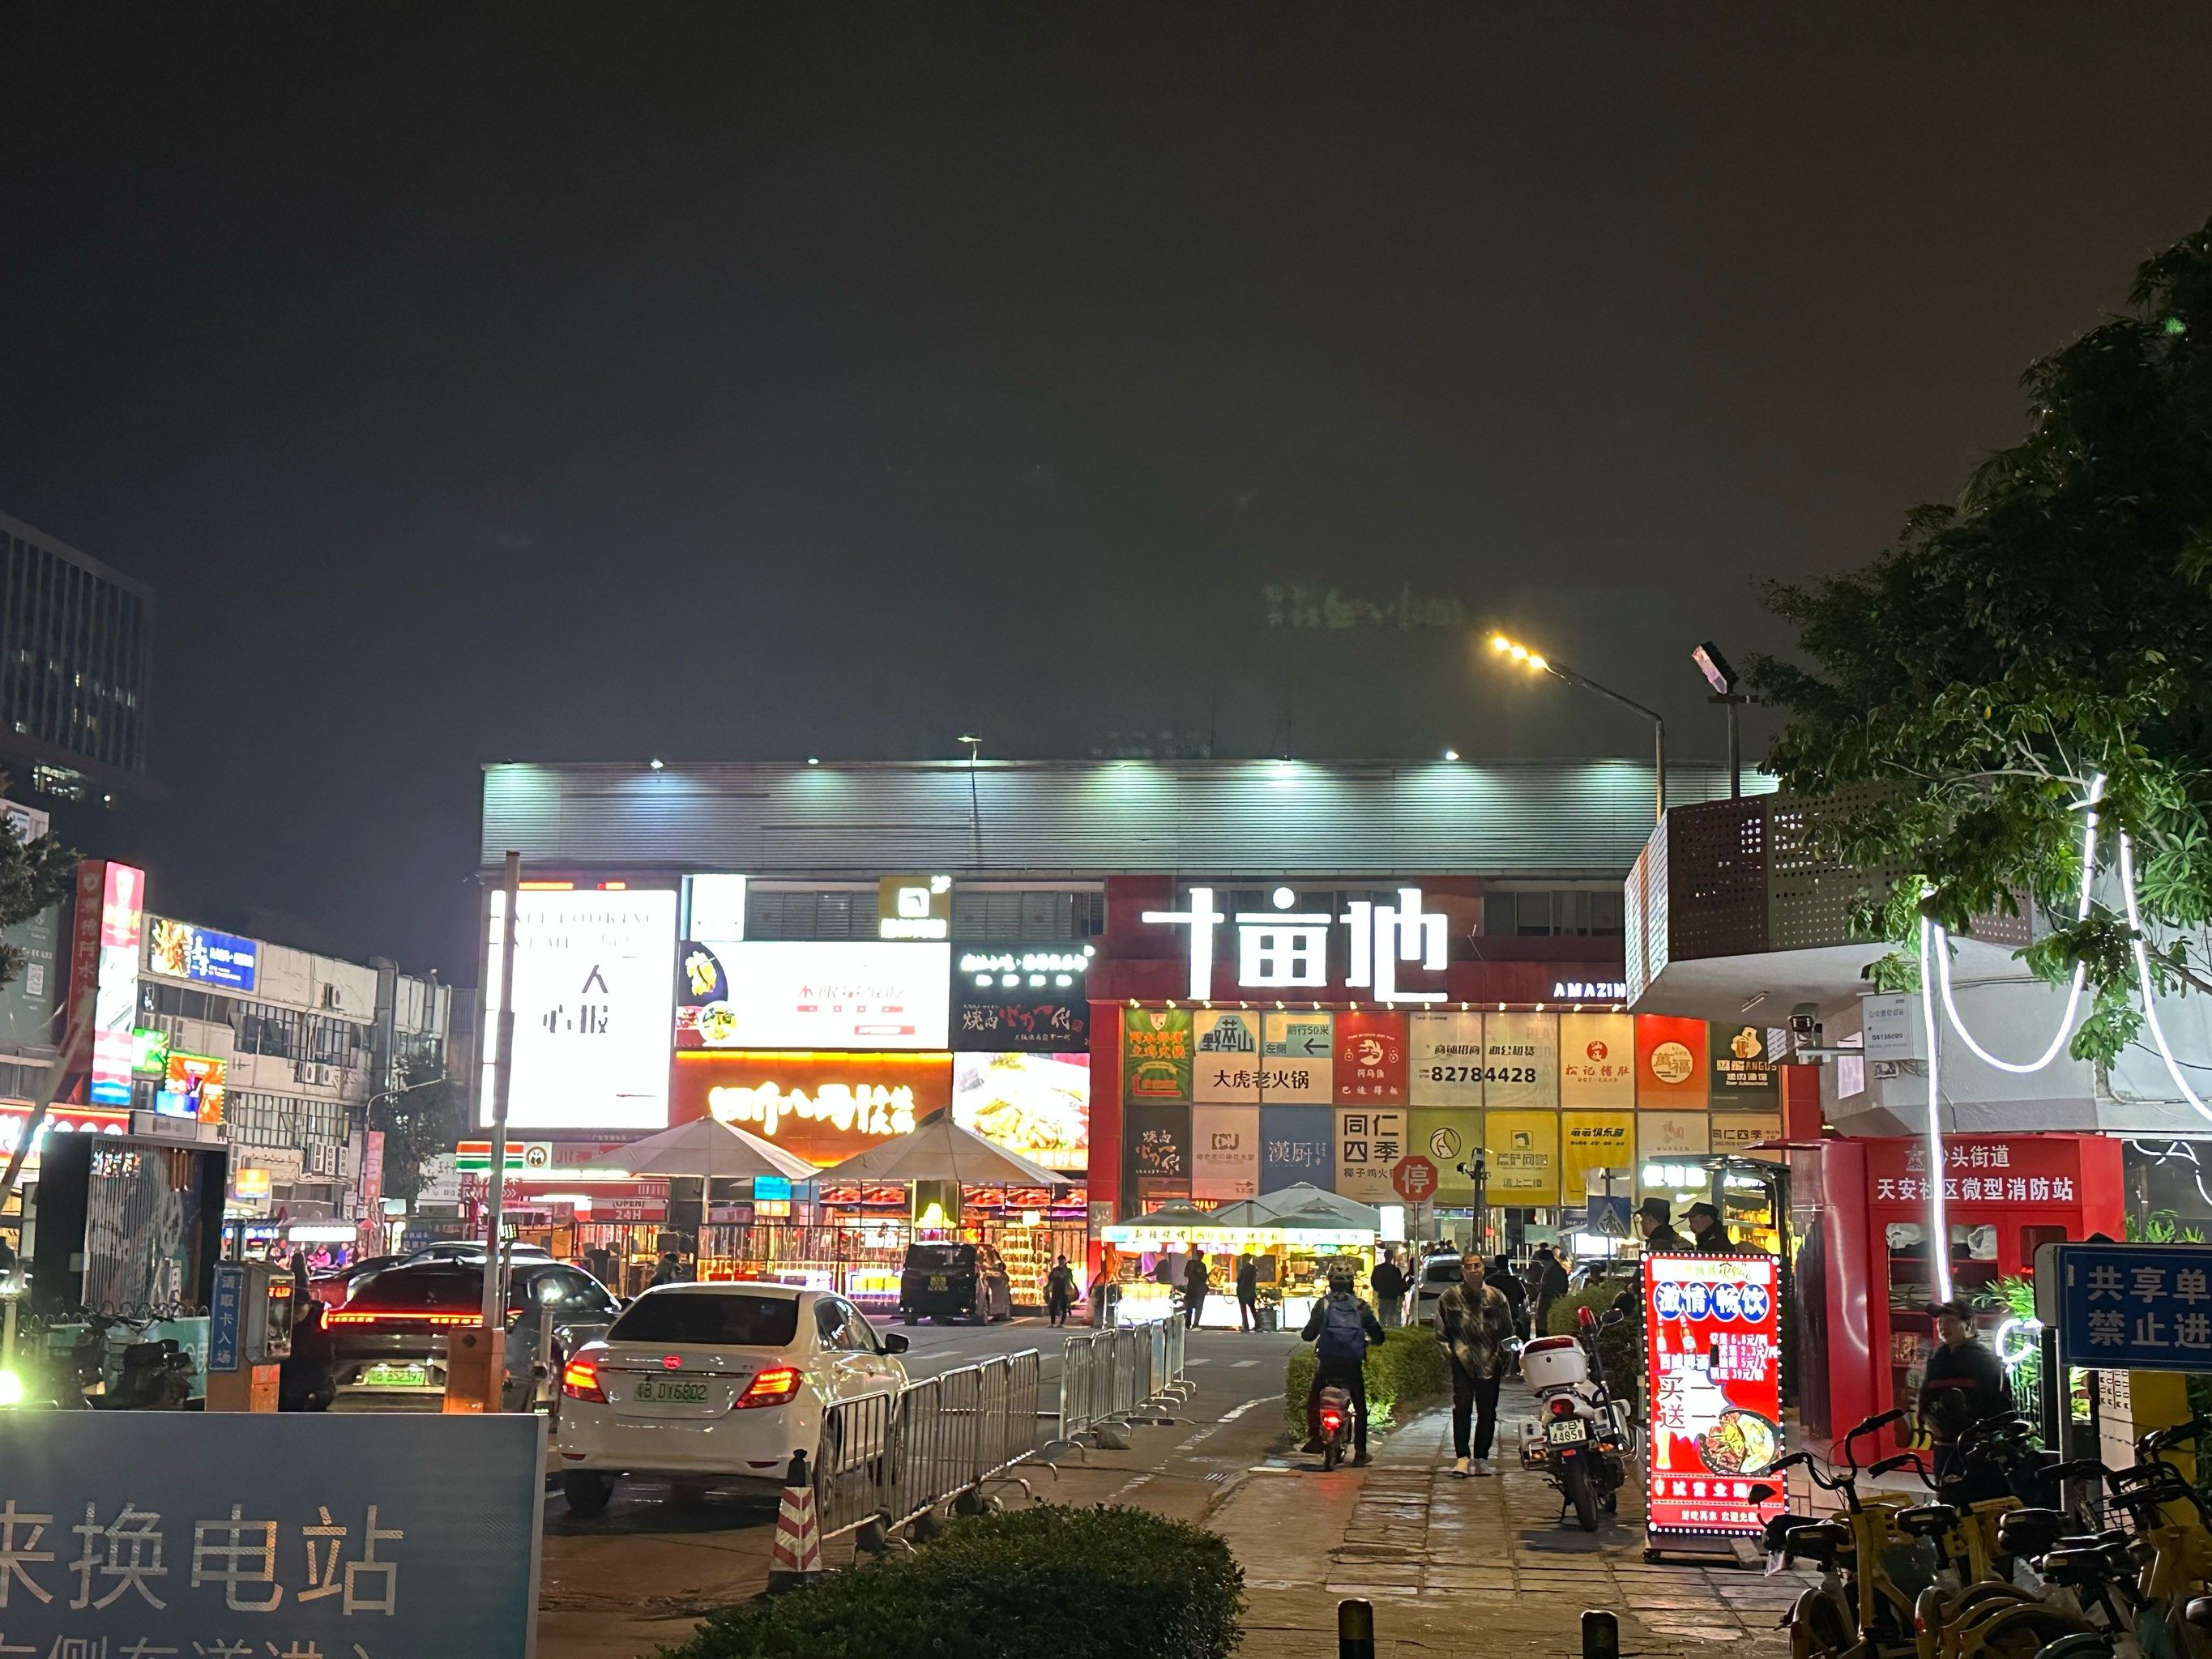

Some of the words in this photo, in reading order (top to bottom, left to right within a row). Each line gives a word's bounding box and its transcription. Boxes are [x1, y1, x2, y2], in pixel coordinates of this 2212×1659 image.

[1142, 886, 1448, 1003] 十亩地
[1553, 983, 1626, 998] AMAZIN
[1287, 1025, 1330, 1036] 前行50米
[1213, 1069, 1309, 1090] 大虎老火锅
[1431, 1066, 1537, 1083] 82784428
[1344, 1115, 1399, 1136] 同仁
[1344, 1141, 1399, 1163] 四季
[1942, 1144, 2010, 1168] 头街道
[1343, 1167, 1394, 1179] 椰子鸡火
[1401, 1164, 1429, 1194] 停
[1877, 1176, 2074, 1201] 天安社区微型消防站
[615, 1209, 642, 1220] 24H
[2086, 1265, 2211, 1305] 共享单
[2088, 1309, 2211, 1350] 禁止进
[1659, 1376, 1716, 1401] 买一
[1659, 1404, 1717, 1429] 送一
[0, 1499, 404, 1617] 来换电站
